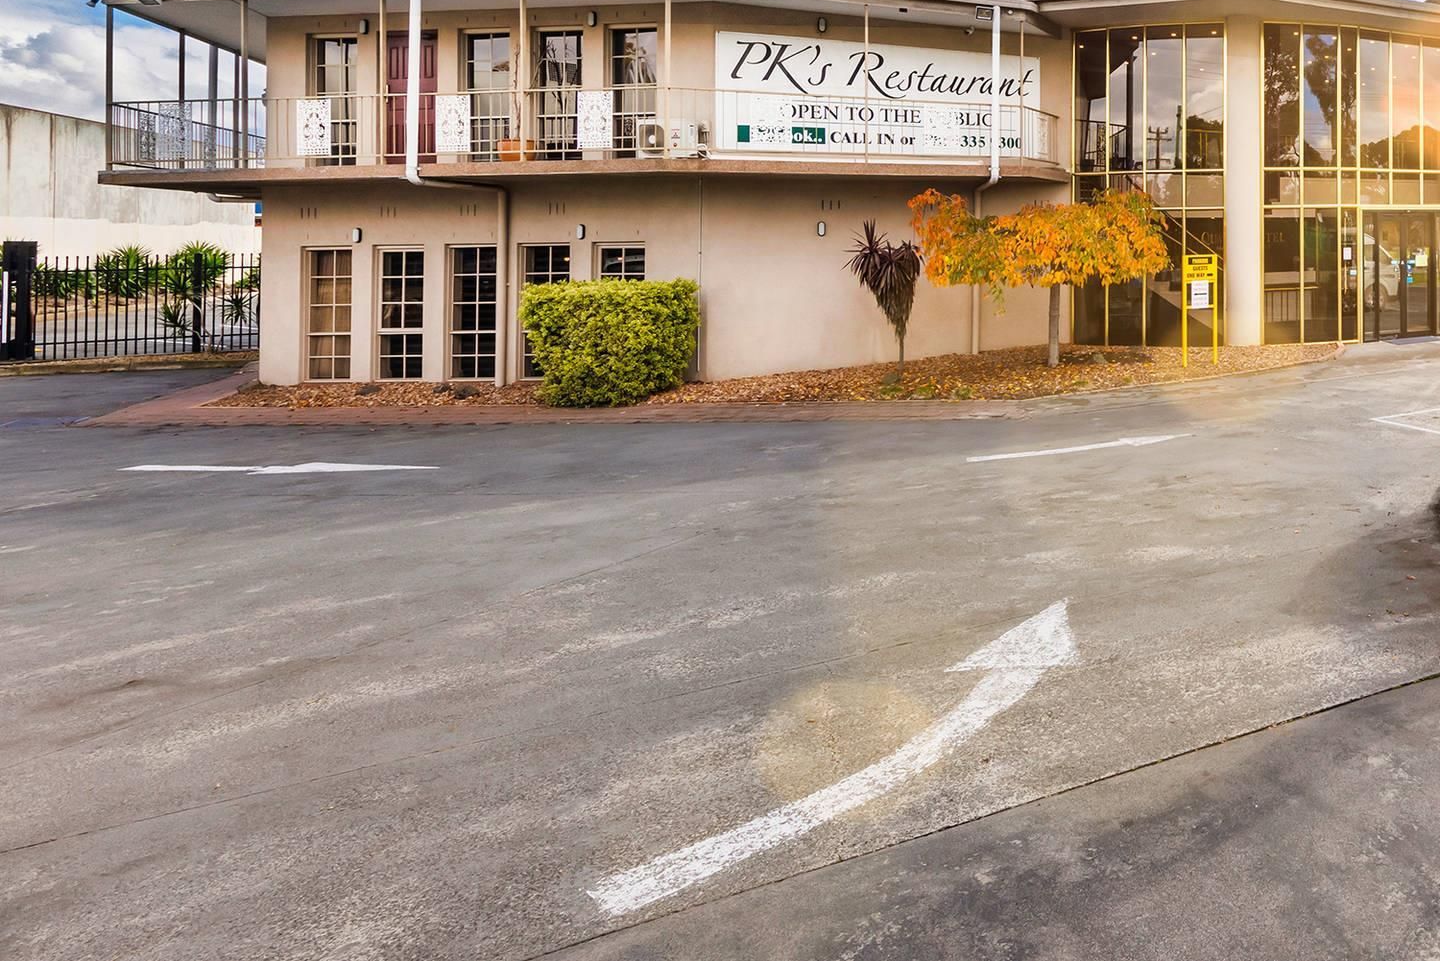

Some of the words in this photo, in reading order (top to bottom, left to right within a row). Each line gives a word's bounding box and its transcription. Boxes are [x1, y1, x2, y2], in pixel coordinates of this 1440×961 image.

[730, 40, 833, 95] PK's
[846, 50, 1034, 100] Restaurant
[845, 106, 874, 122] TO
[880, 108, 922, 124] THE
[830, 131, 872, 145] CALL
[877, 132, 896, 145] IN
[900, 136, 916, 145] or
